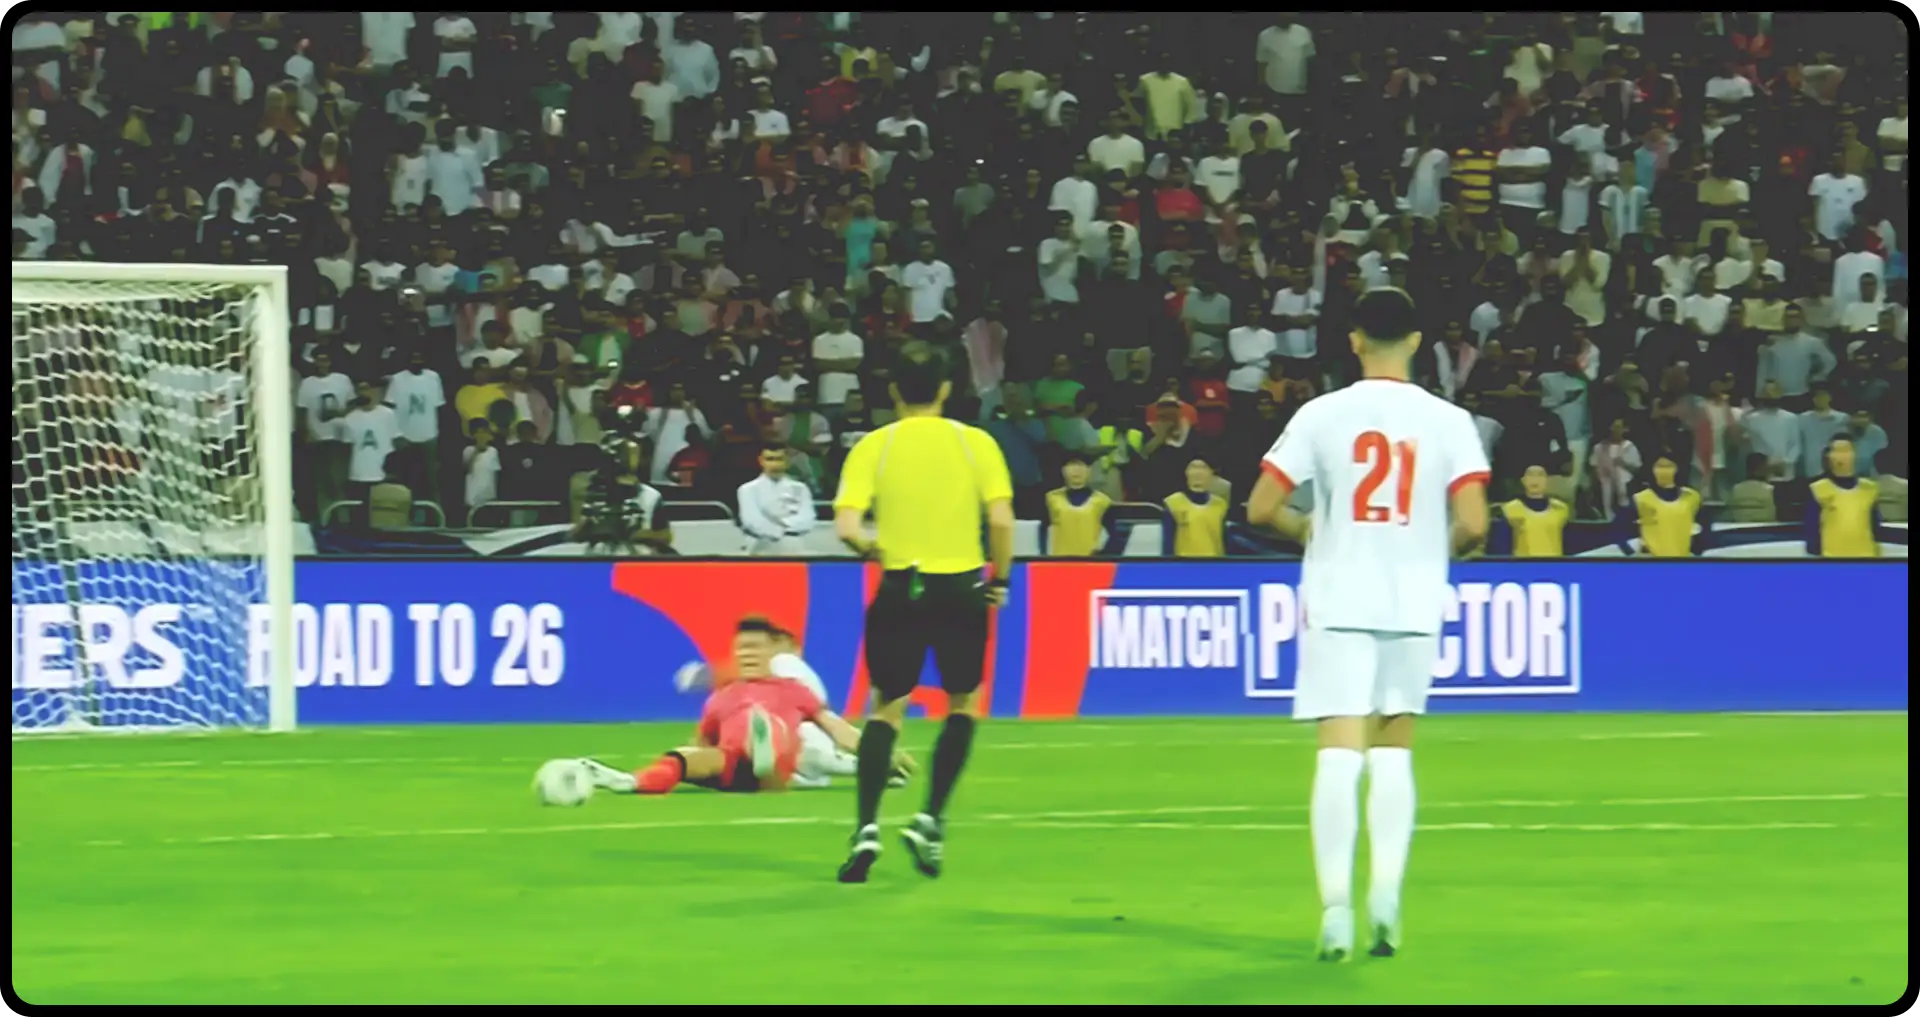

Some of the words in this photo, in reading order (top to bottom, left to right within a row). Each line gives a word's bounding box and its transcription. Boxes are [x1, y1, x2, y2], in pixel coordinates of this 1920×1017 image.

[362, 429, 378, 449] A
[1352, 430, 1417, 526] 21
[408, 603, 475, 686] TO
[491, 603, 565, 686] 26
[1101, 604, 1238, 668] MATCH
[1259, 582, 1566, 679] PCTOR
